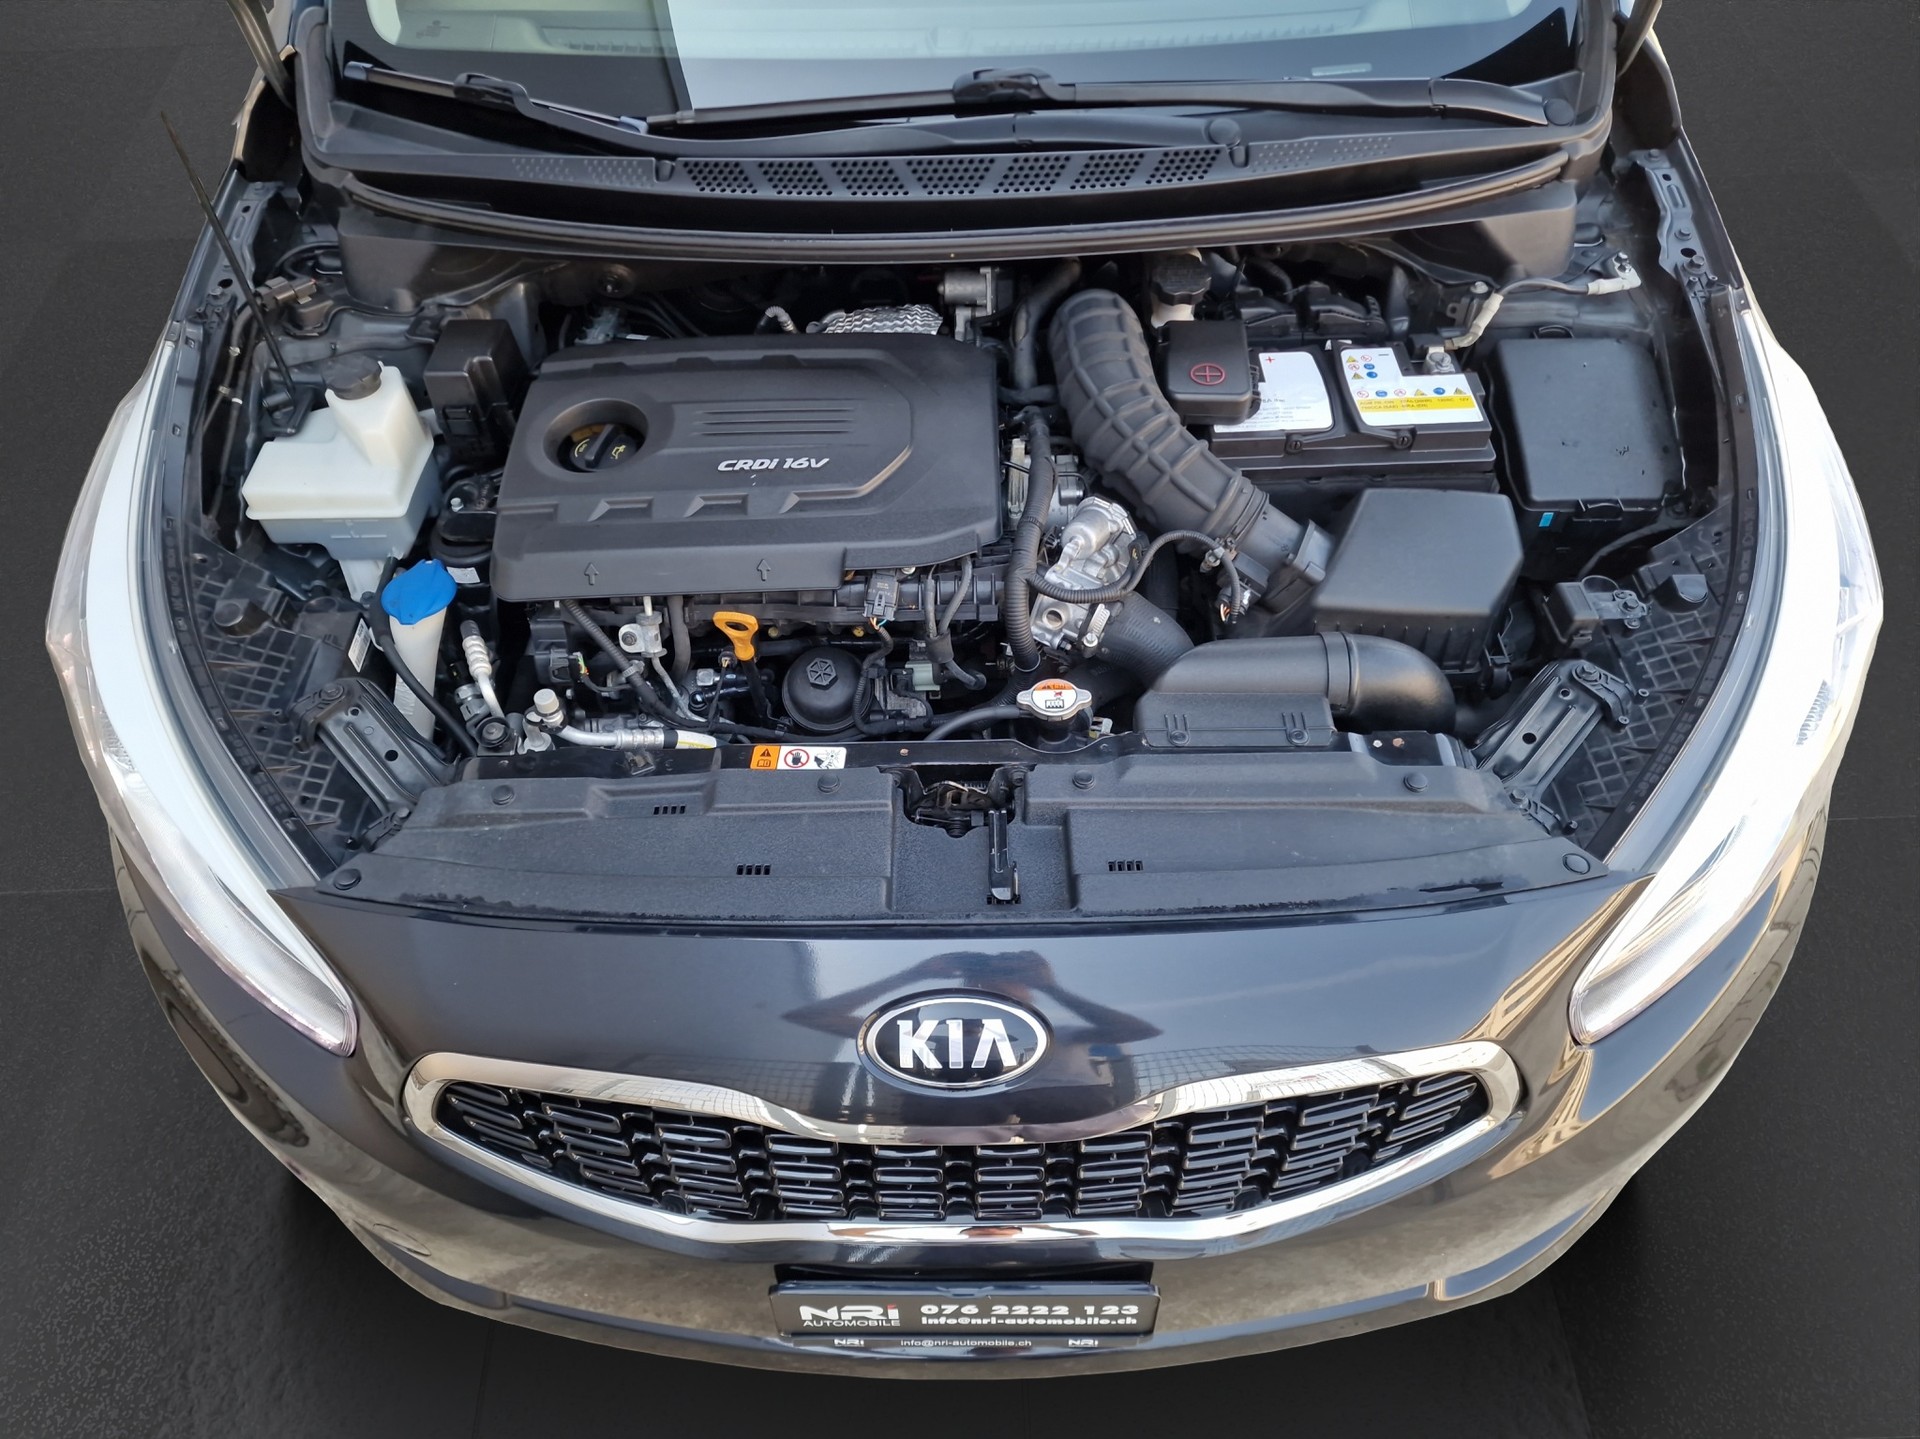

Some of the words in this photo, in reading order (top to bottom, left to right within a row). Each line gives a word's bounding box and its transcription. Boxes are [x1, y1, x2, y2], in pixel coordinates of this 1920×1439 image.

[783, 457, 830, 469] 16V
[897, 1018, 1017, 1069] KIA
[920, 1304, 979, 1315] 076
[990, 1305, 1069, 1315] 2222
[1084, 1305, 1139, 1315] 123
[921, 1317, 1137, 1325] info@nri-automobile.ch
[901, 1339, 1032, 1347] info@nri-automobile.ch
